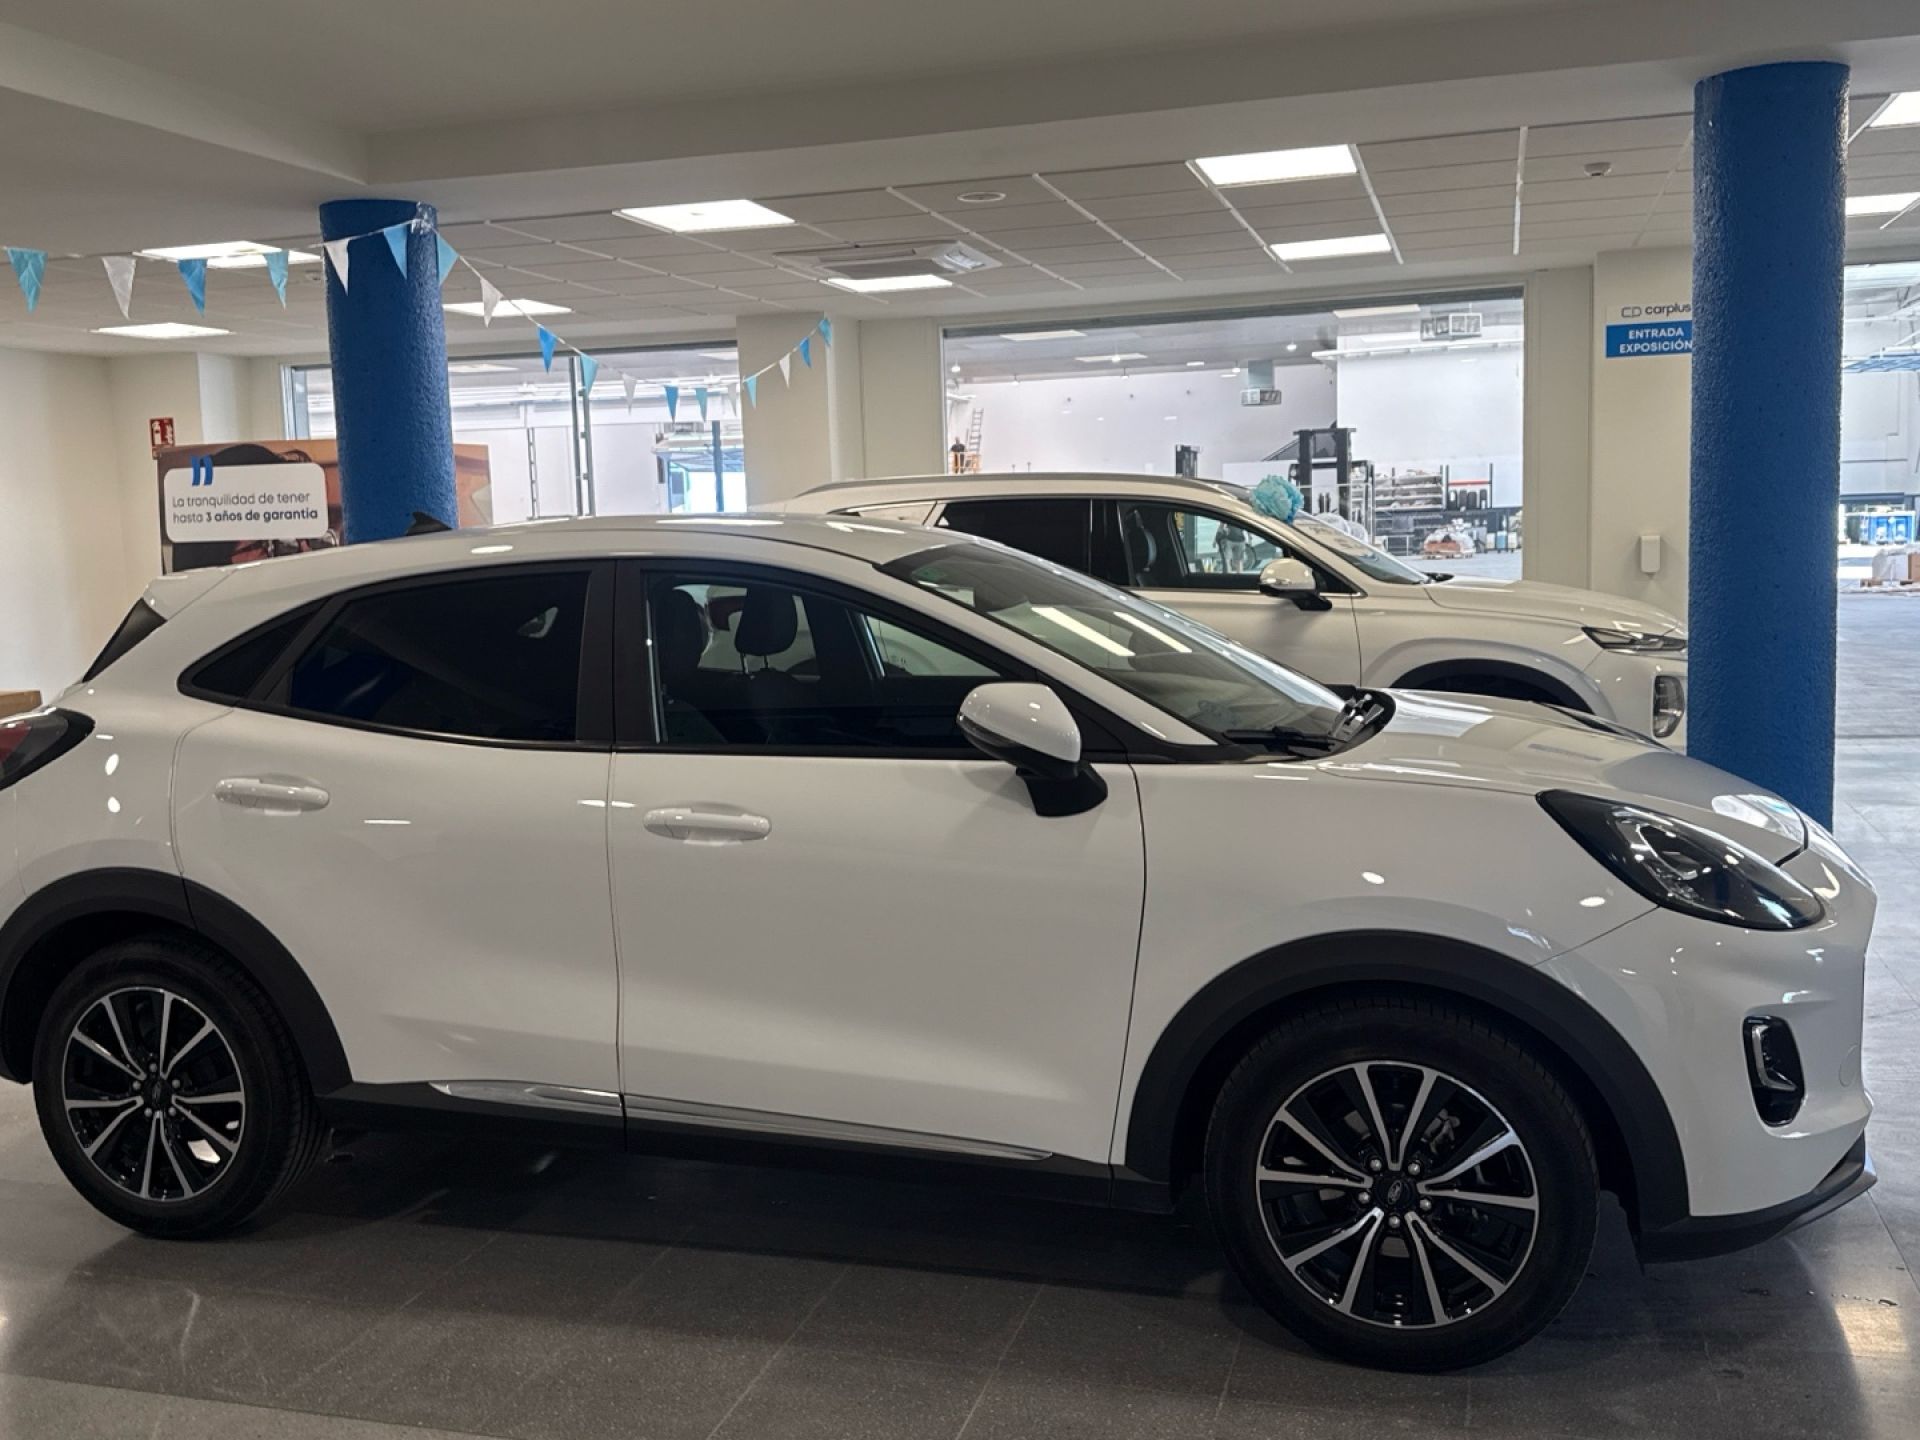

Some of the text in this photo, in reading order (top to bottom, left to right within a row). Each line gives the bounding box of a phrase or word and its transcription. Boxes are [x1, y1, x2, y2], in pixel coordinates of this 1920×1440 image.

[1645, 302, 1691, 316] carplus
[1628, 327, 1684, 339] ENTRADA
[1619, 339, 1692, 353] EXPOSICIÓN
[172, 492, 310, 508] La tranquilidad de tener
[173, 512, 203, 524] hasta
[206, 512, 213, 522] 3
[214, 510, 242, 522] años
[245, 509, 260, 521] de
